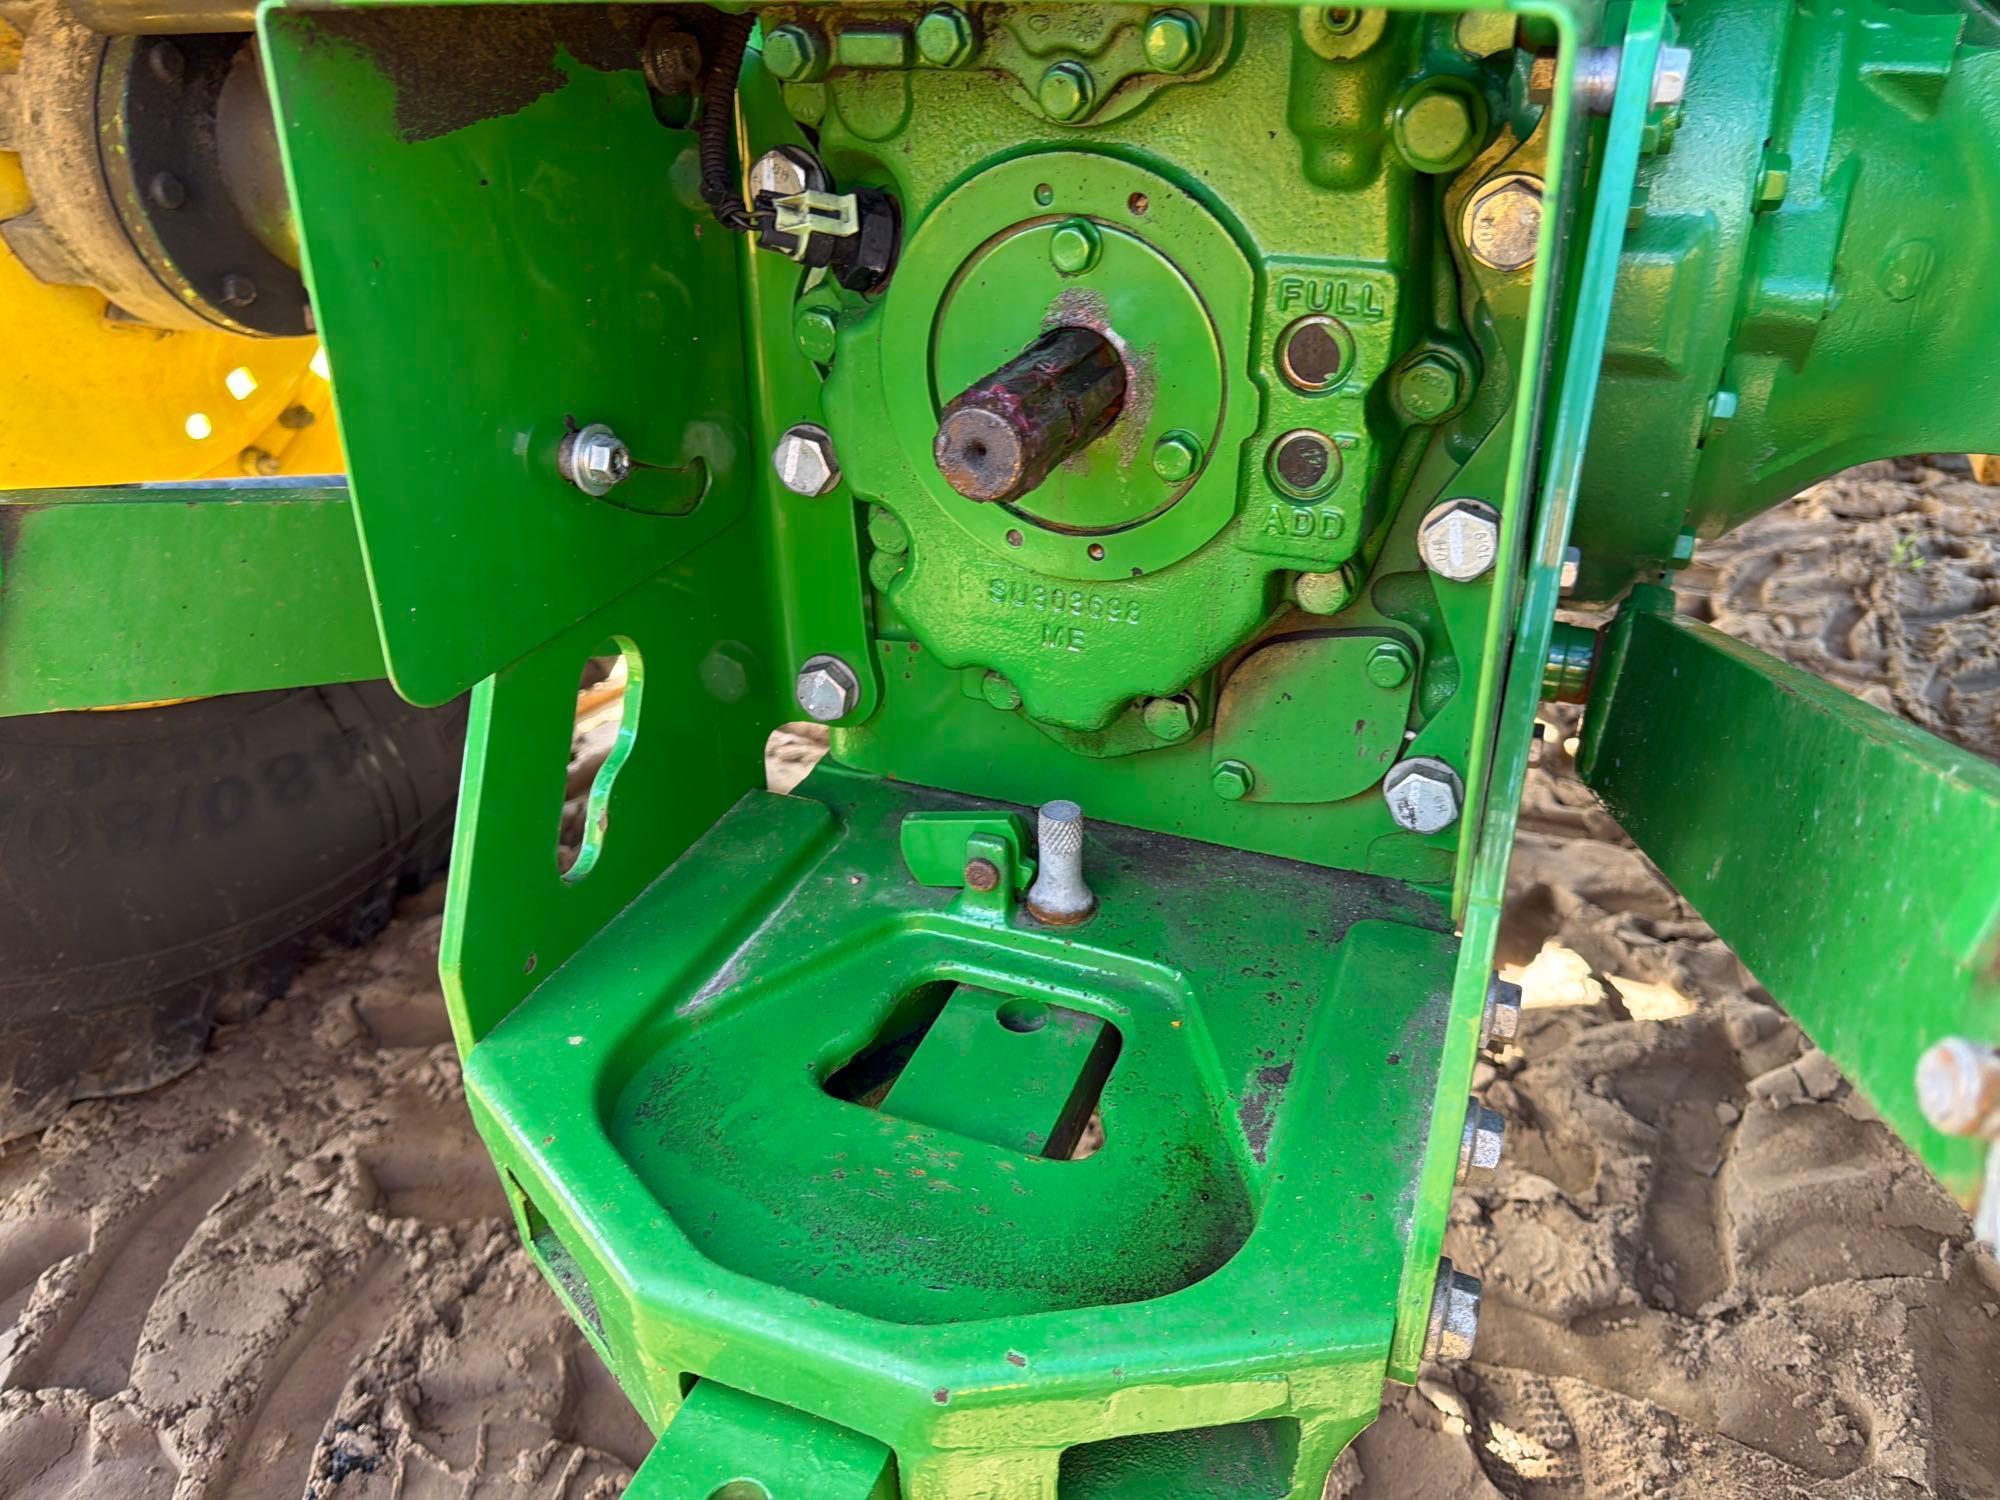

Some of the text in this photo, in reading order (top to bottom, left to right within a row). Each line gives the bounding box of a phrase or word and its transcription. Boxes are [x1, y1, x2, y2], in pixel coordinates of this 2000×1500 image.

[1278, 278, 1384, 317] FULL
[1262, 505, 1345, 540] ADD
[1042, 624, 1085, 652] ME
